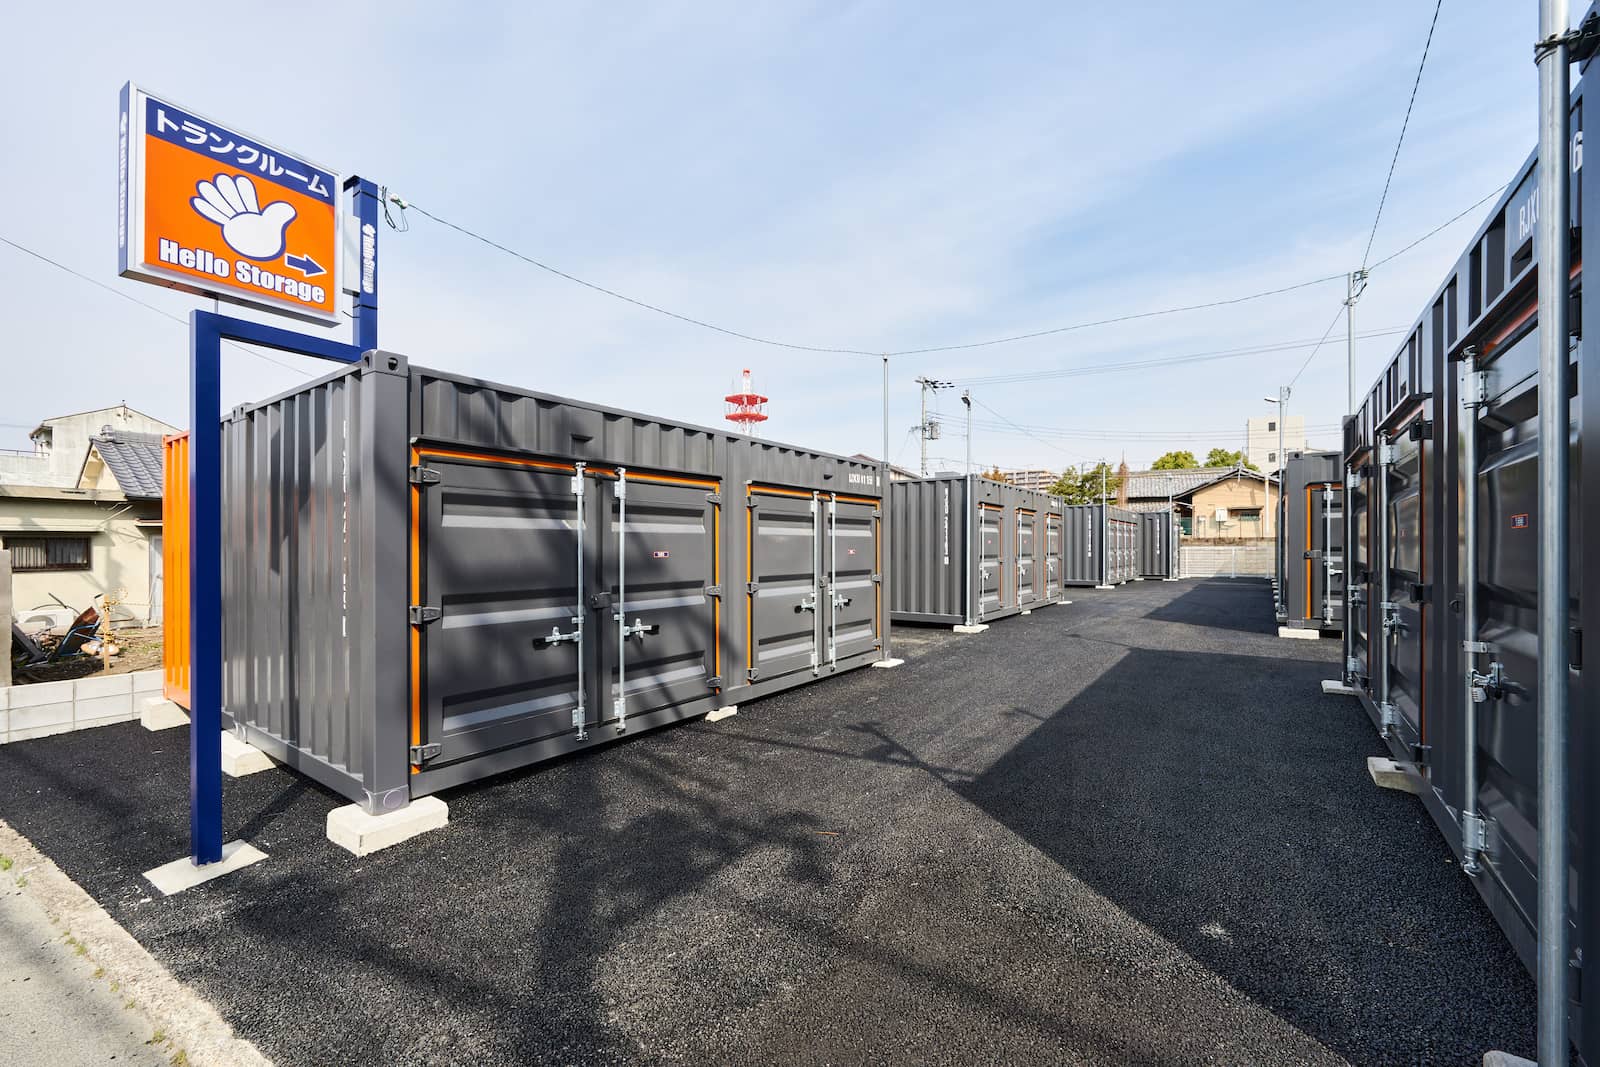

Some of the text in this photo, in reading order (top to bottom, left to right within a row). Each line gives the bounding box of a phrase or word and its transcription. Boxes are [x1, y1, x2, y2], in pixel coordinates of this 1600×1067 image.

[157, 109, 329, 198] トランクルーム
[159, 238, 326, 304] Hello Storage
